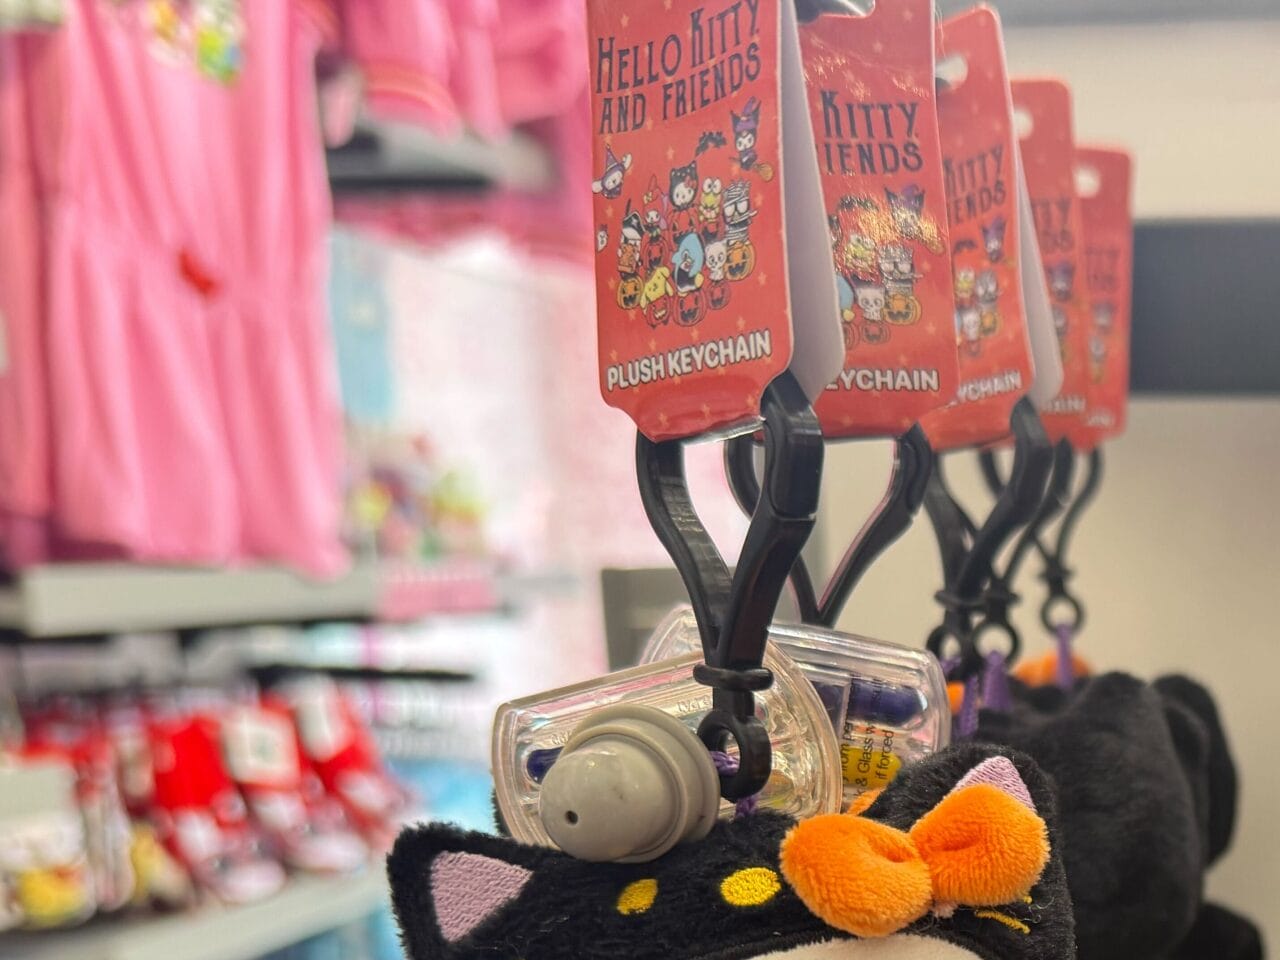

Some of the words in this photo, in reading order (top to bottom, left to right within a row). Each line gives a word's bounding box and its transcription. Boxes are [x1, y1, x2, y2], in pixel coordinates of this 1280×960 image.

[596, 34, 682, 93] HELLO
[690, 0, 759, 68] KITTY
[600, 93, 646, 134] AND
[663, 42, 761, 120] FRIENDS
[820, 90, 919, 139] KITTY
[815, 143, 923, 175] IENDS
[607, 353, 666, 392] PLUSH
[668, 328, 773, 377] KEYCHAIN
[825, 368, 940, 392] YCHAIN
[857, 738, 874, 774] Glass
[877, 729, 894, 769] forced
